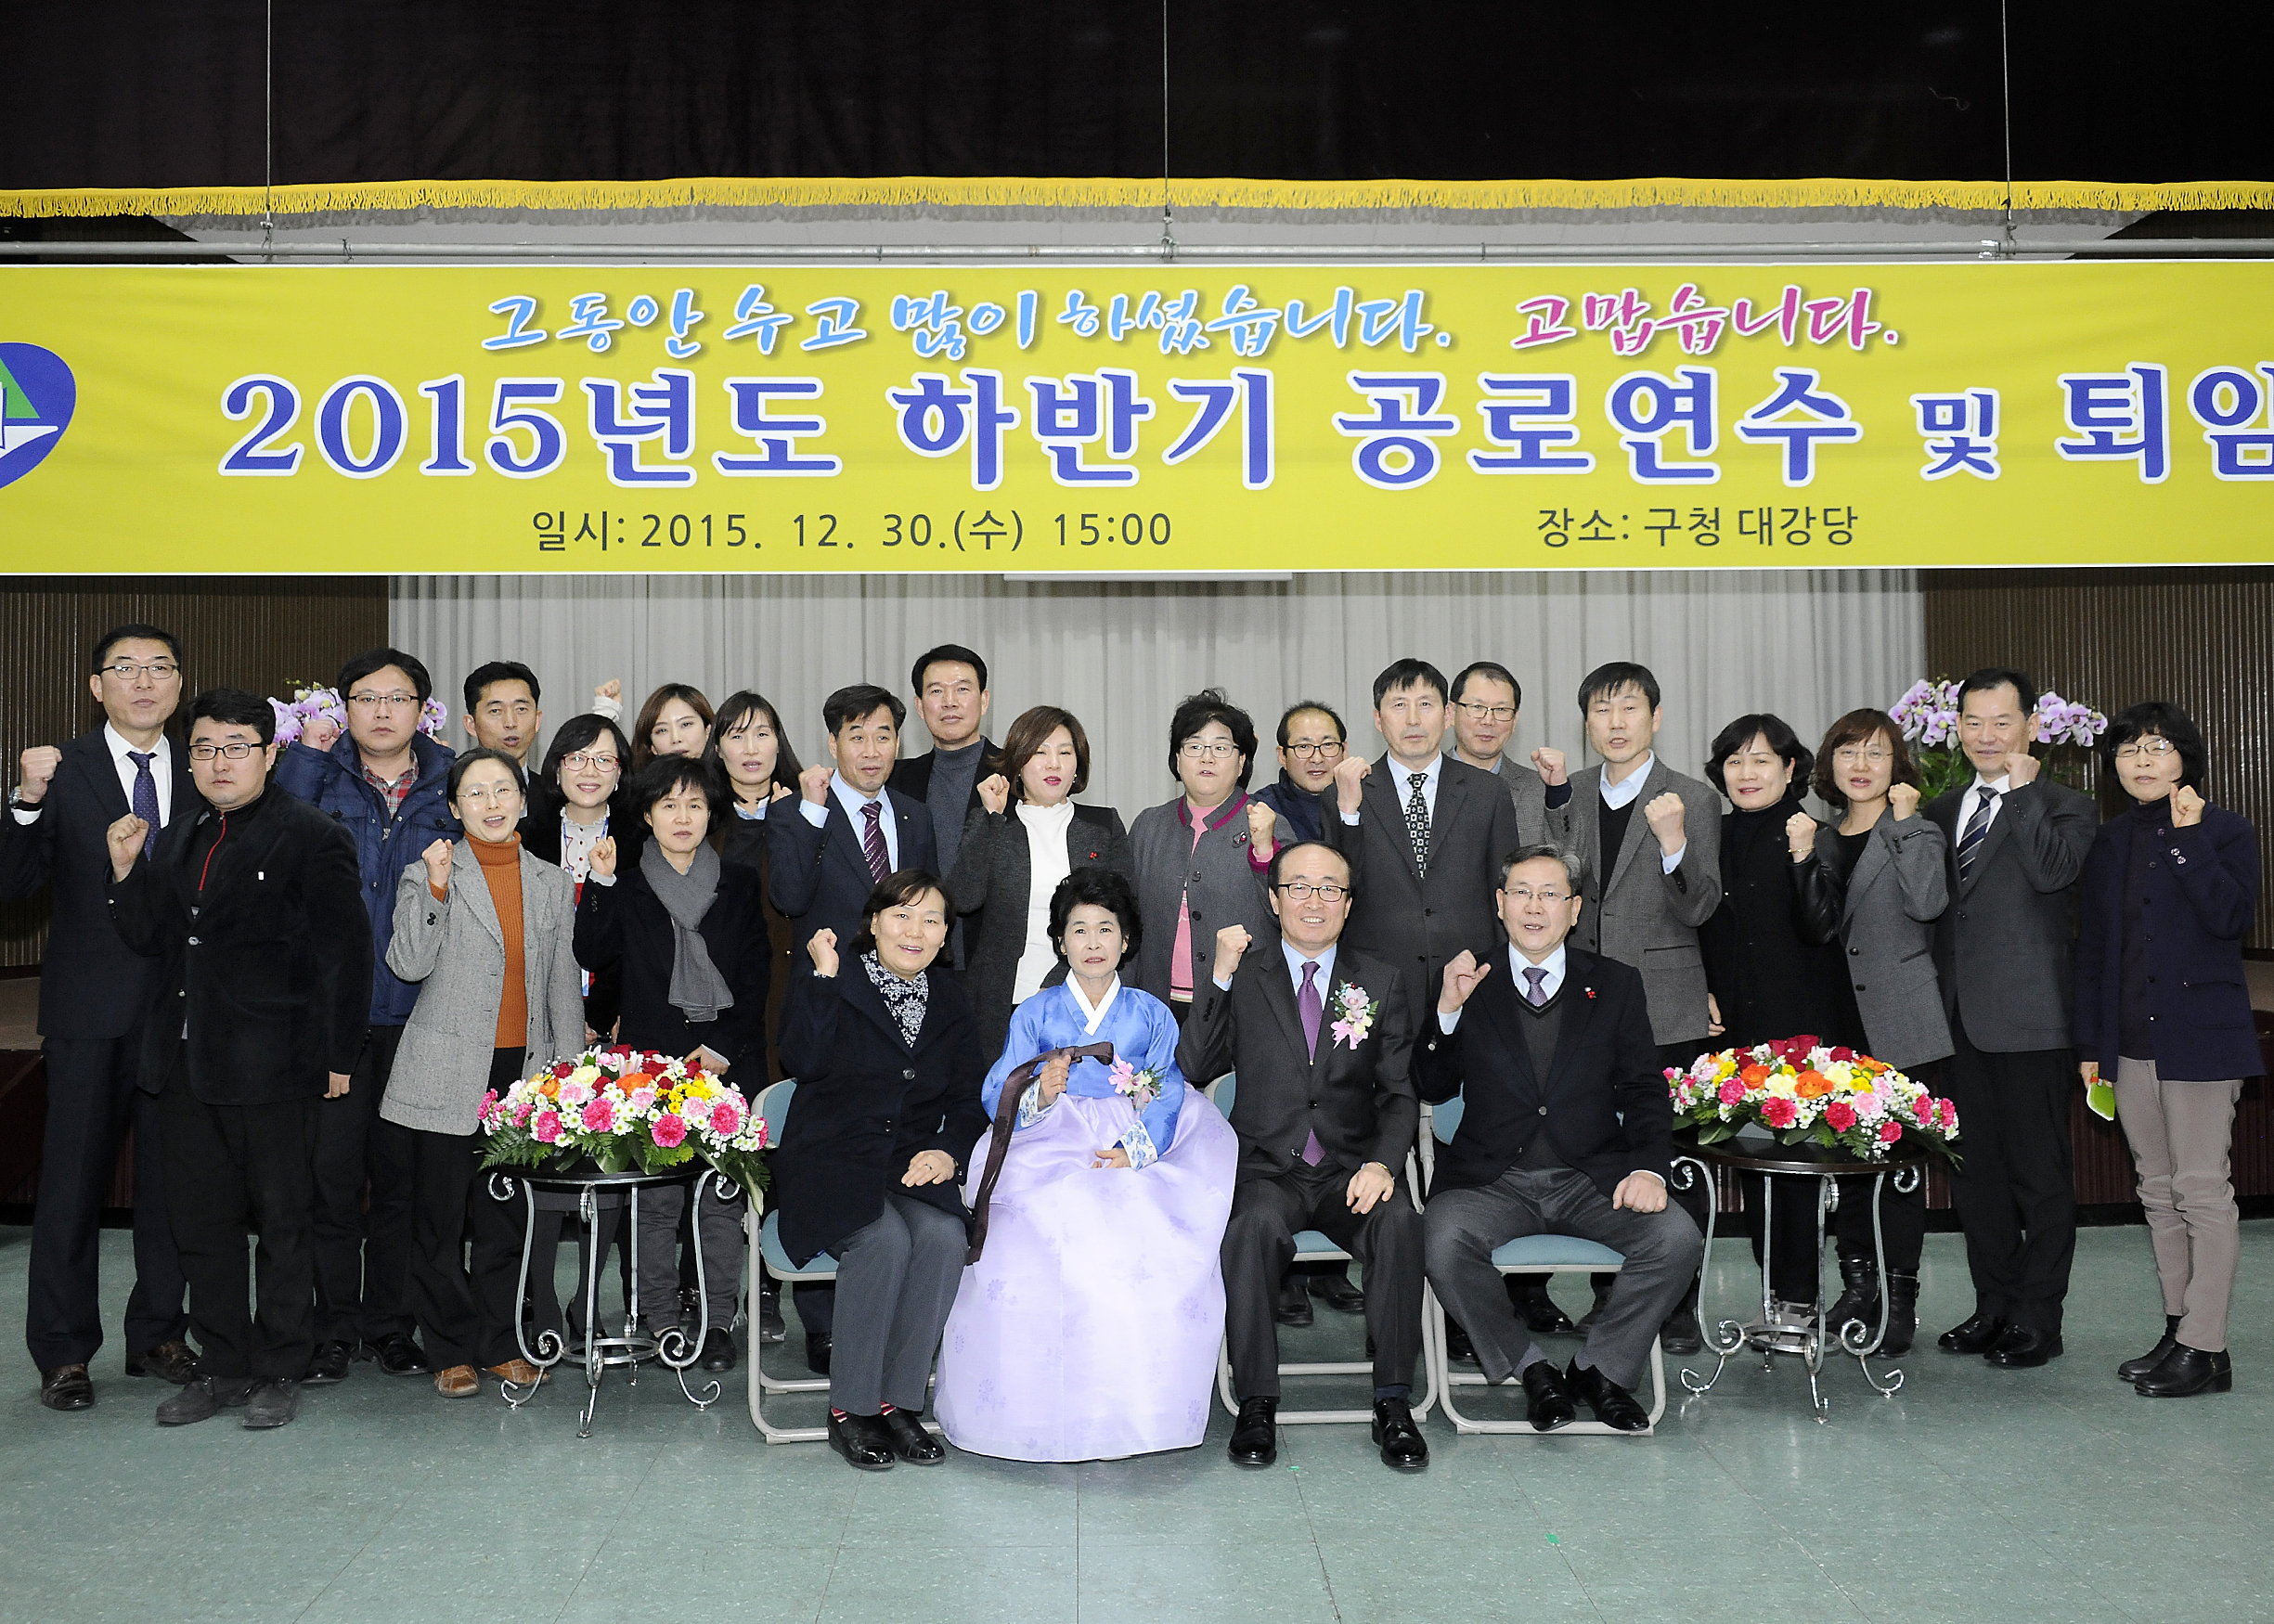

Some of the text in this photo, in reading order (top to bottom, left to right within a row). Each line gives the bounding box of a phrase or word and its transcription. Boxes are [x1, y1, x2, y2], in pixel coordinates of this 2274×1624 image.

[483, 285, 1450, 360] 그동안 수고 많이 하셨습니다.
[1513, 286, 1897, 354] 고맙습니다.
[221, 364, 2274, 488] 2015년도 하반기 공로연수 및 퇴임
[532, 509, 1172, 553] 일시: 2015. 12. 30.(수) 15:00
[1536, 505, 1861, 549] 장소: 구청 대강당
